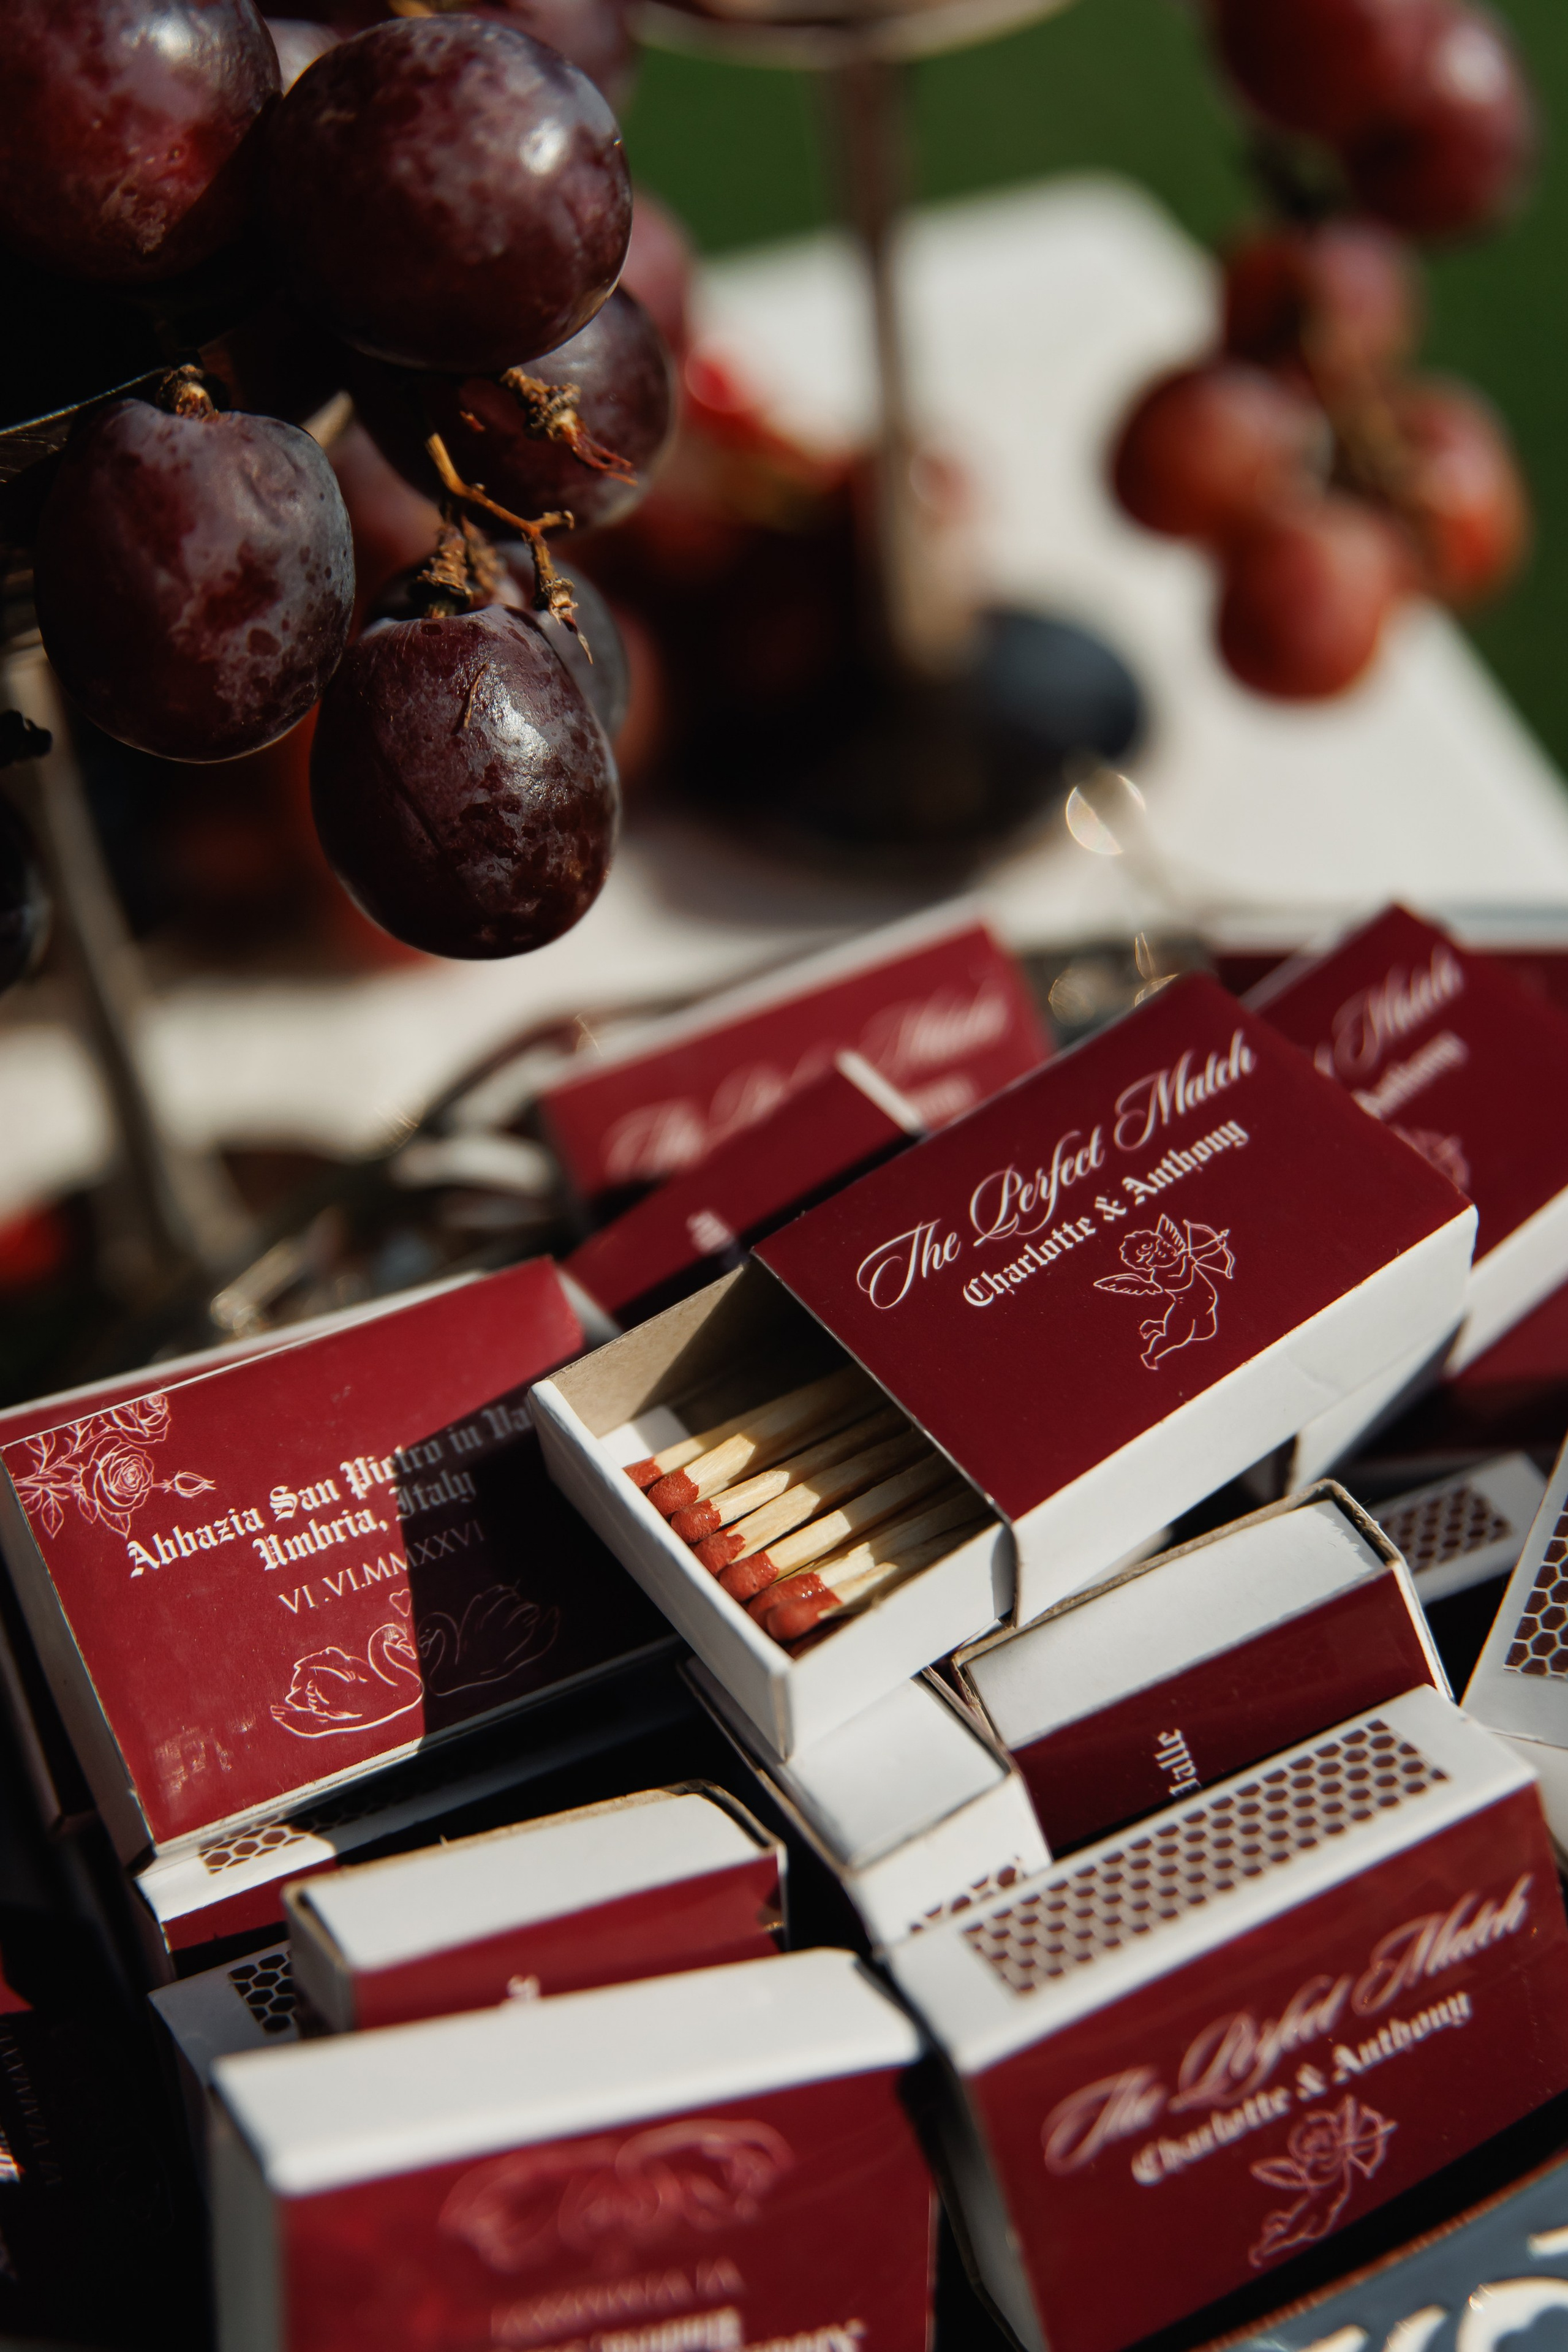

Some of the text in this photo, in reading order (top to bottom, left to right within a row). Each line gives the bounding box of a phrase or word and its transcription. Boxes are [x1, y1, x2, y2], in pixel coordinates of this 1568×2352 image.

[856, 1218, 961, 1310] The
[970, 1125, 1104, 1248] Perfect
[1113, 1028, 1256, 1151] Match
[963, 1120, 1250, 1307] Charlotte & Anthony
[127, 1506, 265, 1578] Abbazia
[270, 1478, 341, 1523] San
[339, 1444, 443, 1501] Pietro
[448, 1427, 484, 1455] in
[252, 1469, 477, 1571] Umbria, Italy
[1130, 2086, 1291, 2187] Charlotte
[1332, 1991, 1472, 2083] Anthony
